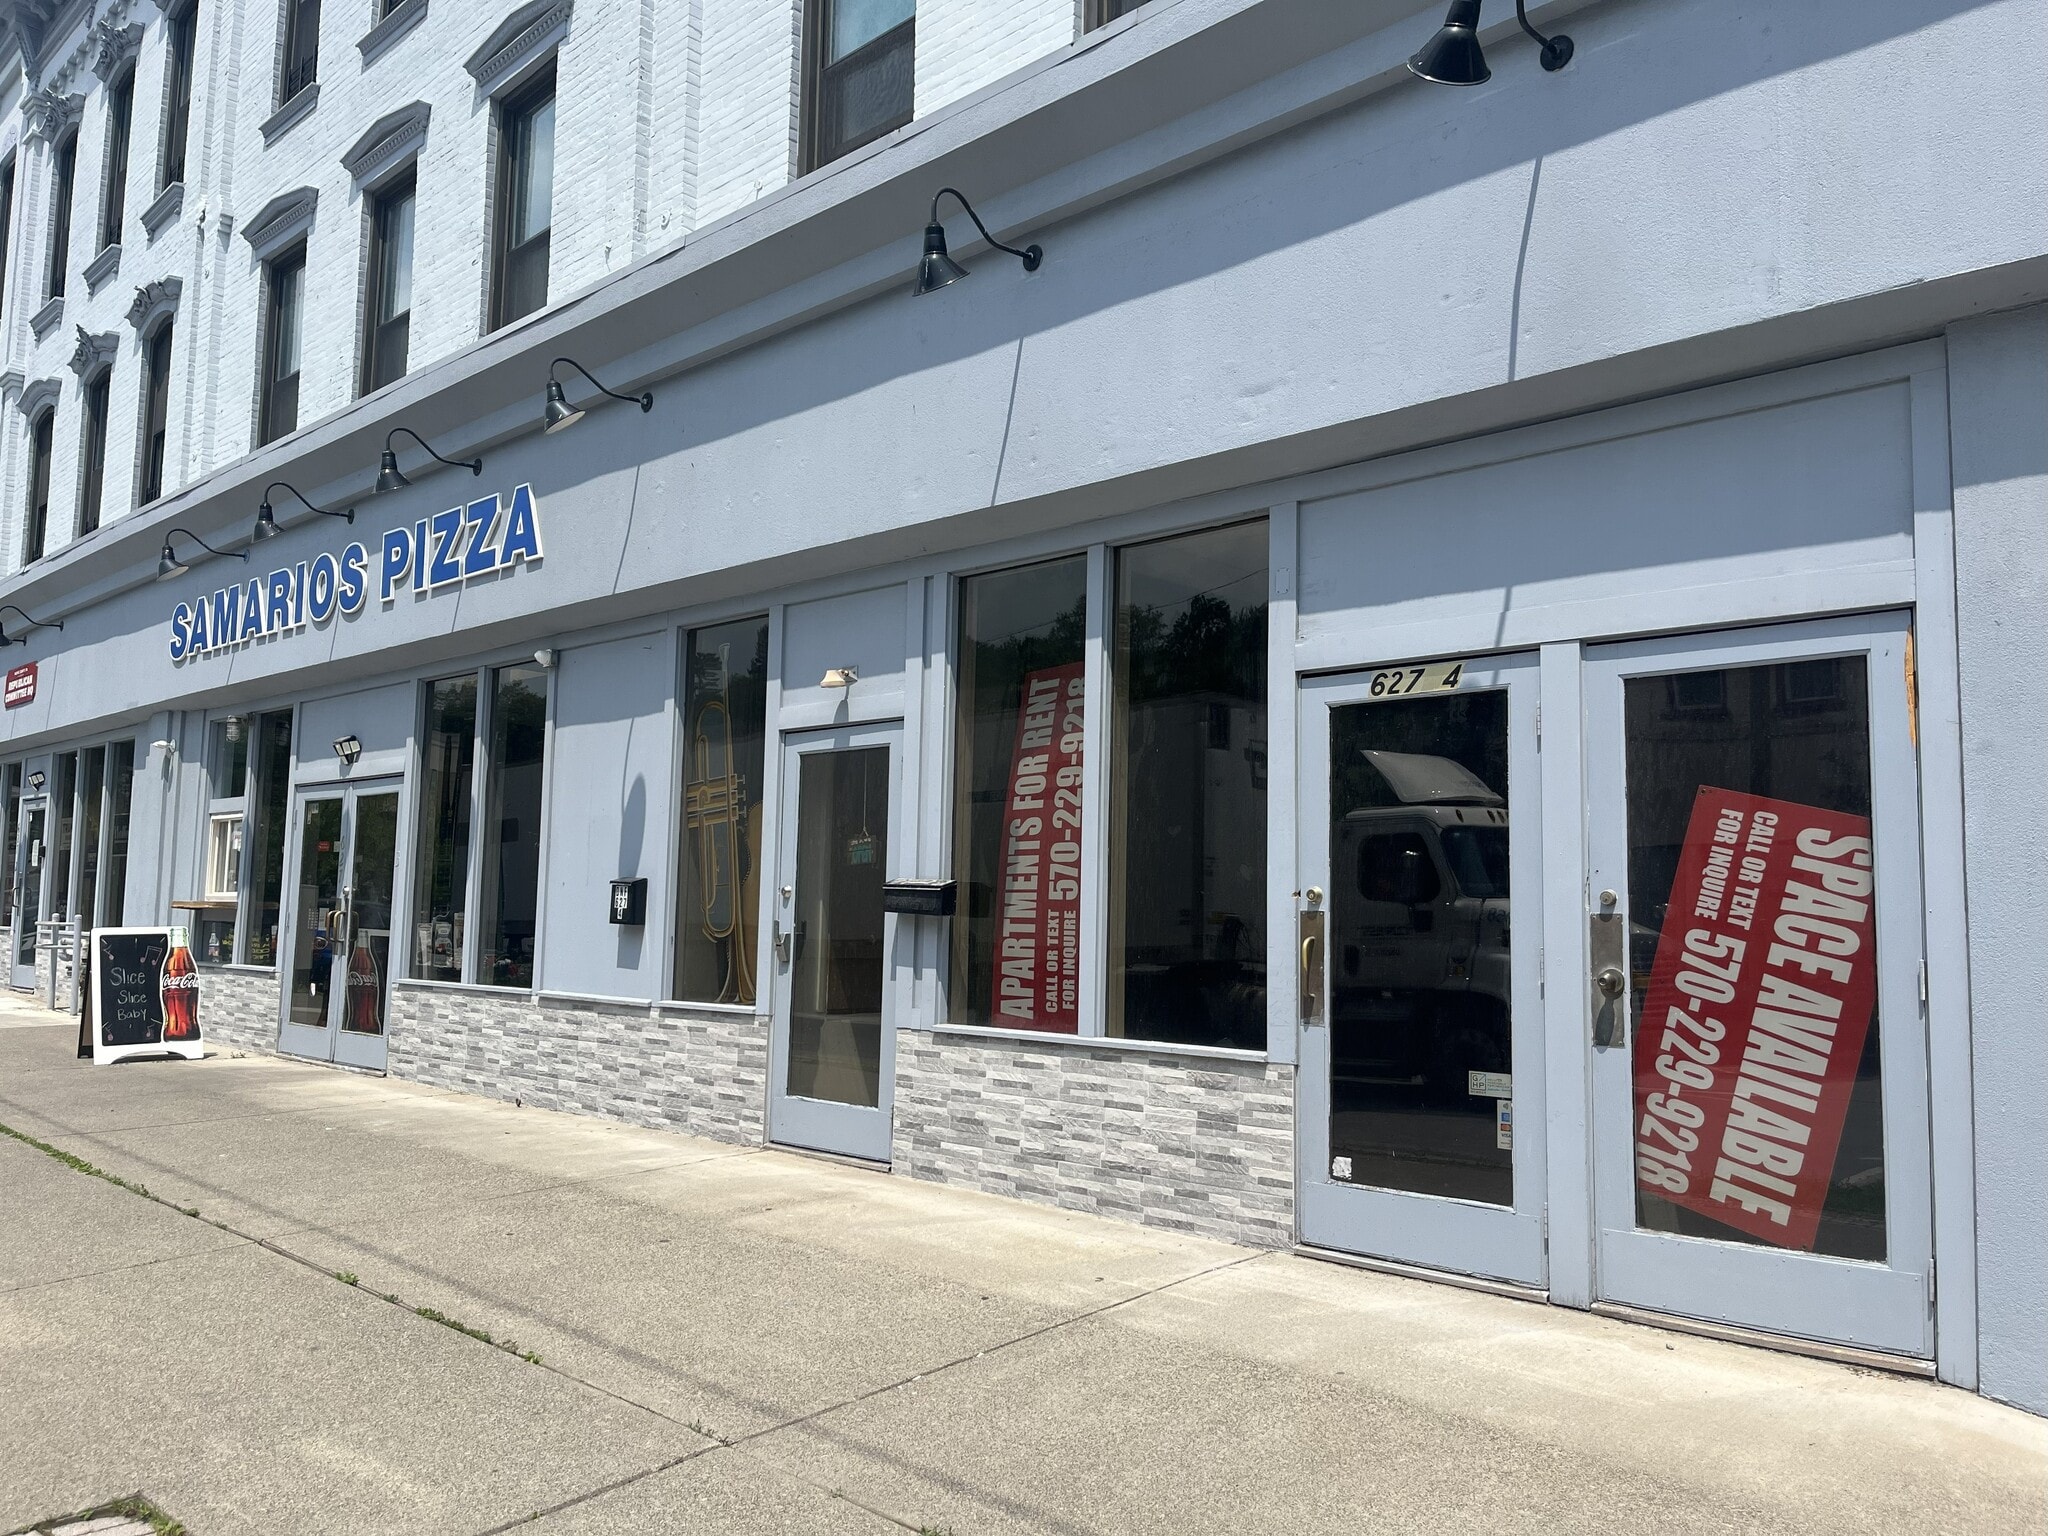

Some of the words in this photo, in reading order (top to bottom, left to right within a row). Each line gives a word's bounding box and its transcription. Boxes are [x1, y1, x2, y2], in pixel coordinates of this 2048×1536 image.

[169, 541, 368, 661] SAMARIOS
[380, 482, 543, 602] PIZZA
[1370, 668, 1426, 696] 627
[1442, 664, 1462, 688] 4
[1021, 678, 1060, 749] RENT
[1013, 754, 1049, 811] FOR
[1713, 808, 1744, 845] FOR
[1745, 810, 1778, 854] CALL
[1694, 846, 1734, 921] INQUIRE
[1738, 856, 1766, 884] OR
[1000, 816, 1042, 1019] APARTMENTS
[1727, 886, 1760, 930] TEXT
[1766, 827, 1873, 984] SPACE
[1047, 909, 1060, 947] TEXT
[1062, 910, 1077, 975] INQUIRE
[110, 967, 146, 986] Slice
[1046, 950, 1059, 972] OR
[117, 990, 148, 1004] Slice
[1045, 975, 1058, 1013] CALL
[1062, 979, 1075, 1010] FOR
[1638, 928, 1747, 1194] 570-229-9218
[1709, 973, 1843, 1226] AVAILABLE
